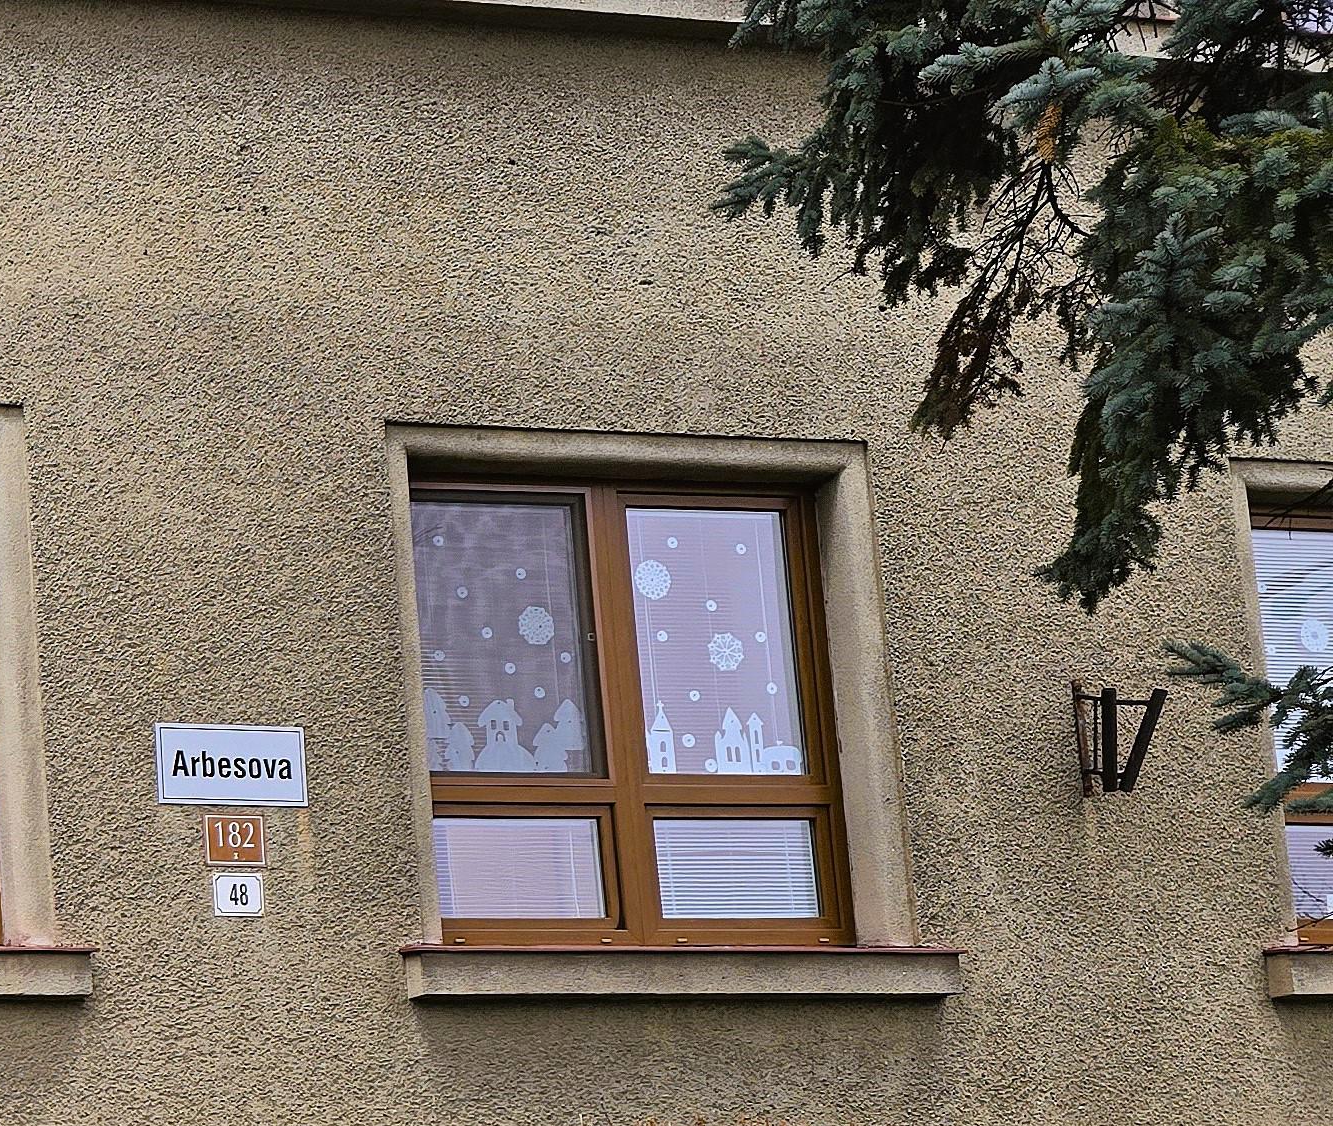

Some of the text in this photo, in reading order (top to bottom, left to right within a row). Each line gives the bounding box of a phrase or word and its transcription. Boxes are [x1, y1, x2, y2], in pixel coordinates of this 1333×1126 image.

[172, 749, 293, 780] Arbesova
[214, 821, 255, 848] 182
[229, 883, 249, 906] 48
